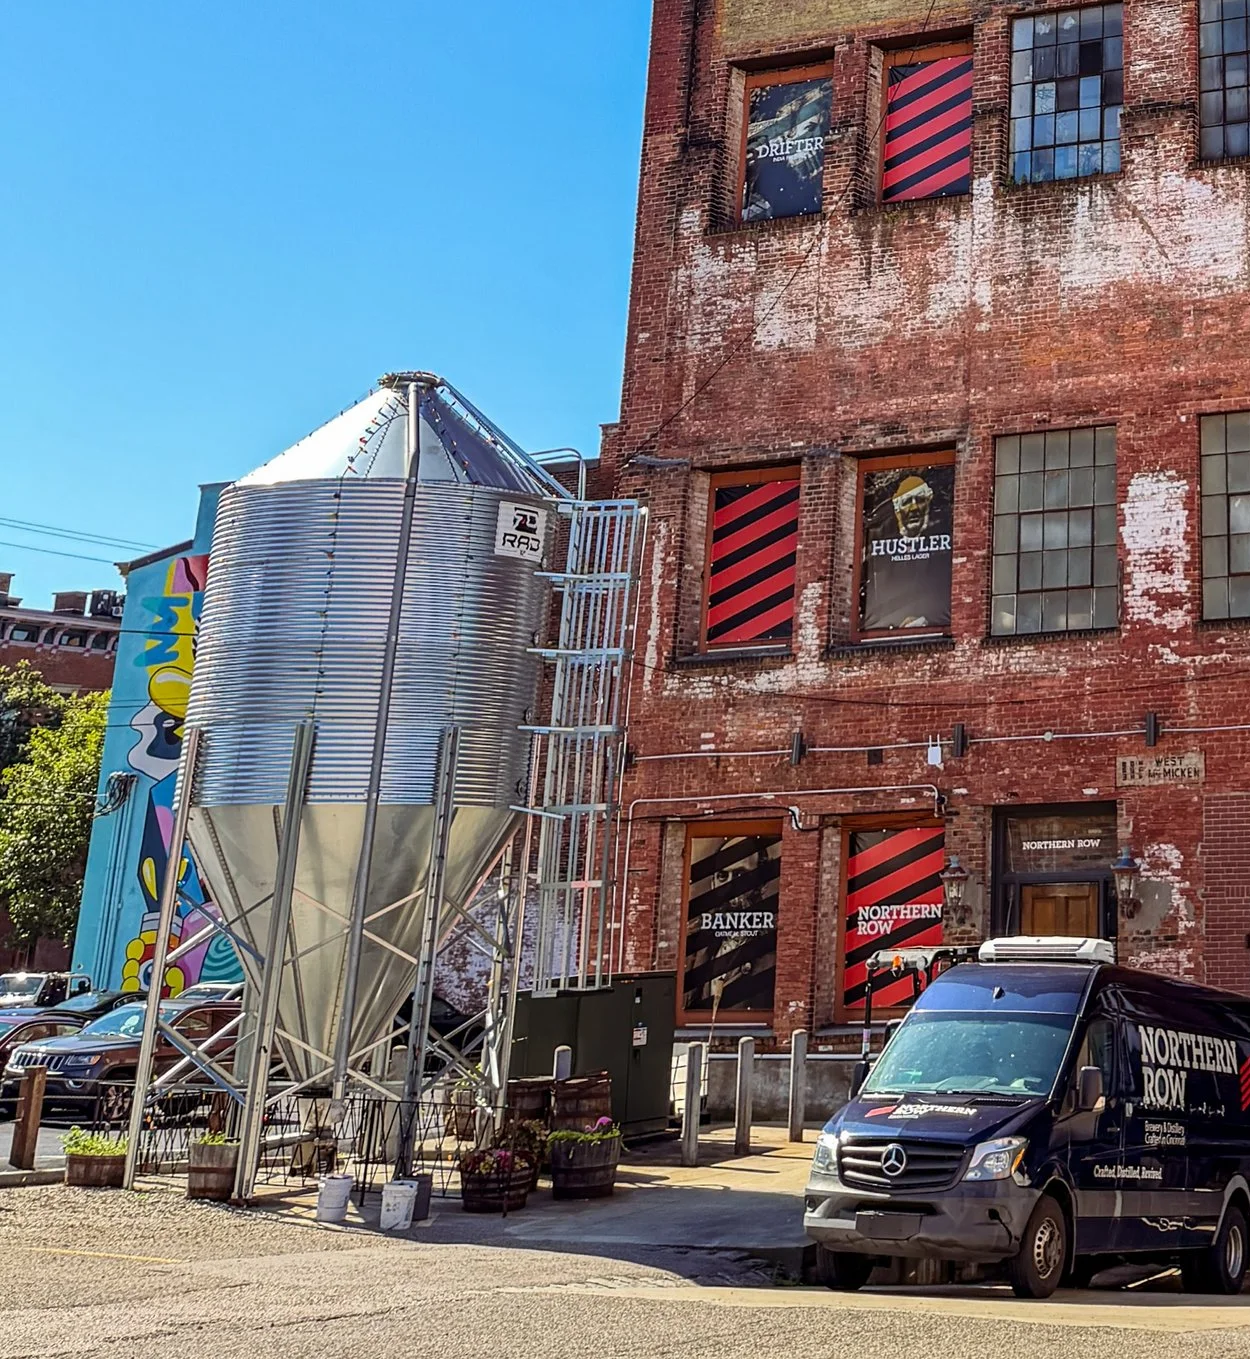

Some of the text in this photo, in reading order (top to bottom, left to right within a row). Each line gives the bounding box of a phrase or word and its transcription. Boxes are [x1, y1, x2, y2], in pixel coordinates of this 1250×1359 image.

[755, 136, 824, 159] DRIFTER
[871, 534, 952, 556] HUSTLER
[1154, 756, 1185, 766] WEST
[1022, 838, 1101, 851] NORTHERN ROW
[700, 911, 774, 930] BANKER
[857, 903, 944, 921] NORTHERN
[740, 929, 759, 937] STOUT
[857, 920, 895, 936] ROW
[1138, 1024, 1239, 1076] NORTHERN
[1141, 1065, 1188, 1108] ROW
